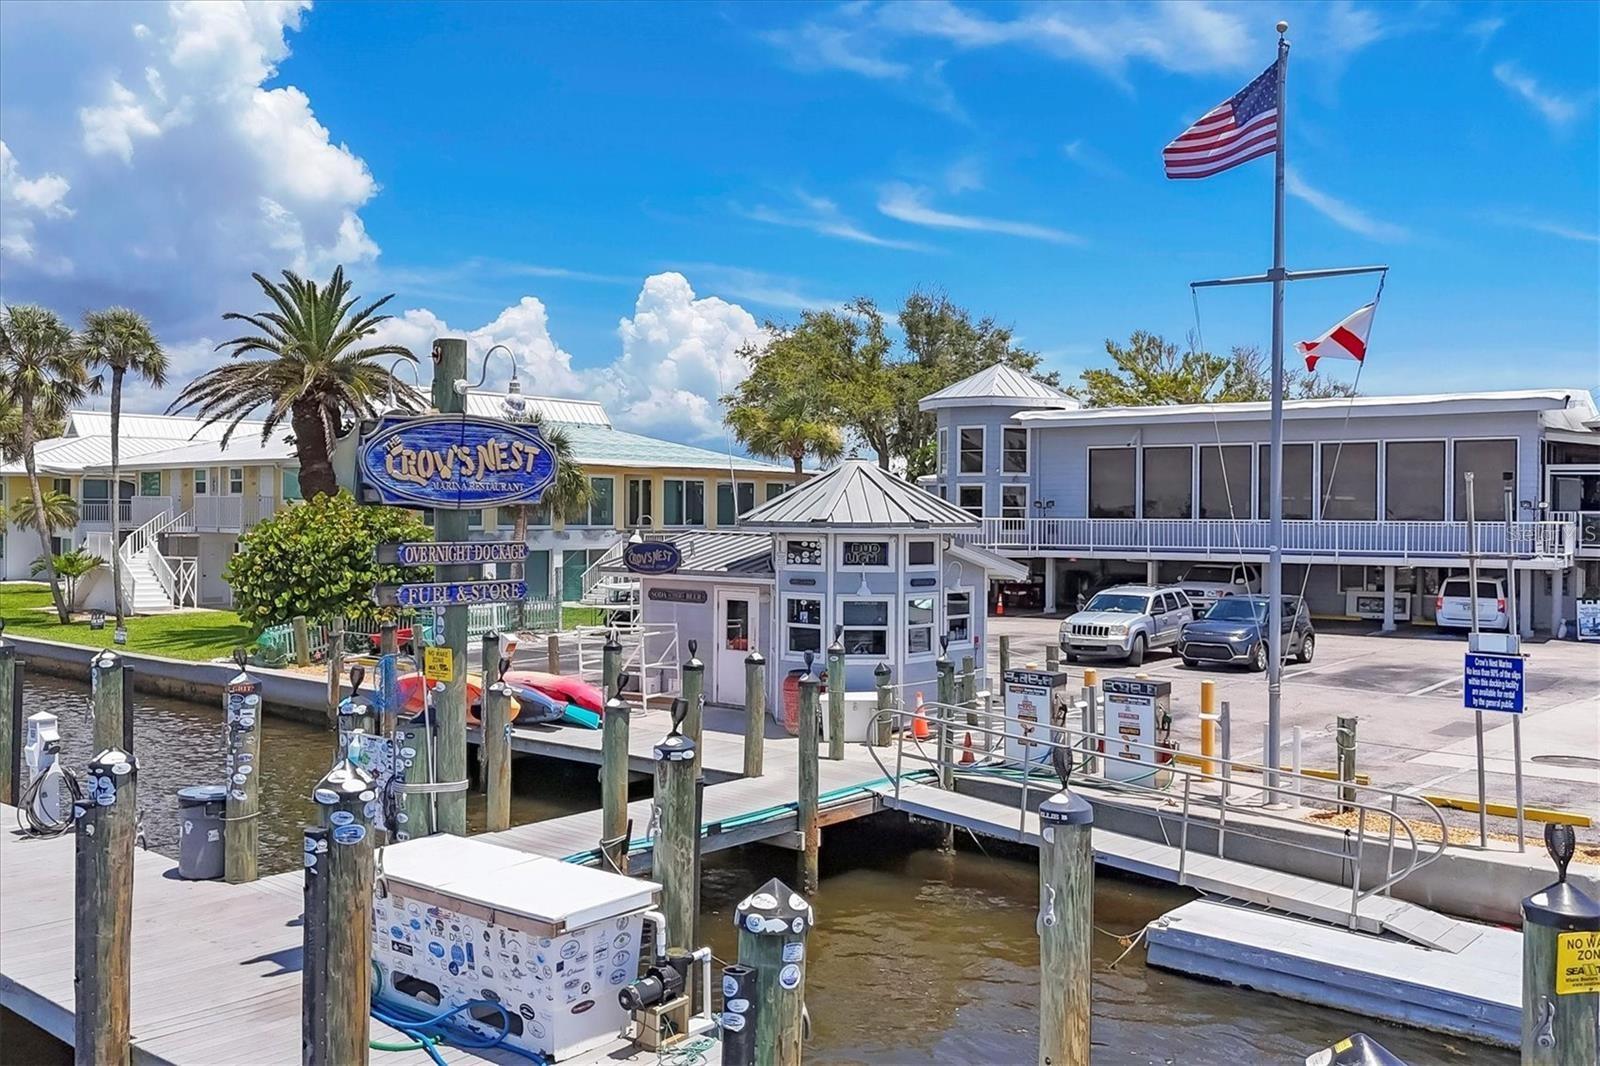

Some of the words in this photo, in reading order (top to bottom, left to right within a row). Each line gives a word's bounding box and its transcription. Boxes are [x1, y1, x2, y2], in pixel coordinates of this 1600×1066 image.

[384, 434, 402, 451] THE
[386, 444, 475, 486] CROW'S
[476, 438, 540, 481] NEST
[431, 481, 469, 491] MARINA
[469, 482, 525, 493] RESTAURANT
[405, 546, 474, 562] OVERNIGHT
[475, 545, 525, 559] DOCKAGE
[408, 588, 451, 605] FUEL
[457, 587, 467, 600] &
[469, 584, 521, 601] STORE
[1488, 659, 1498, 667] Nest
[1499, 659, 1512, 668] Marina
[1466, 667, 1472, 675] No
[1472, 668, 1480, 676] less
[1481, 668, 1490, 677] than
[1468, 678, 1480, 686] within
[1489, 679, 1505, 690] docking
[1505, 680, 1519, 691] facility
[1479, 689, 1497, 698] available
[1503, 691, 1515, 699] rental
[1472, 698, 1478, 707] by
[1485, 699, 1501, 708] general
[1501, 700, 1514, 709] public
[1567, 939, 1583, 949] NO
[1566, 967, 1585, 976] SEA
